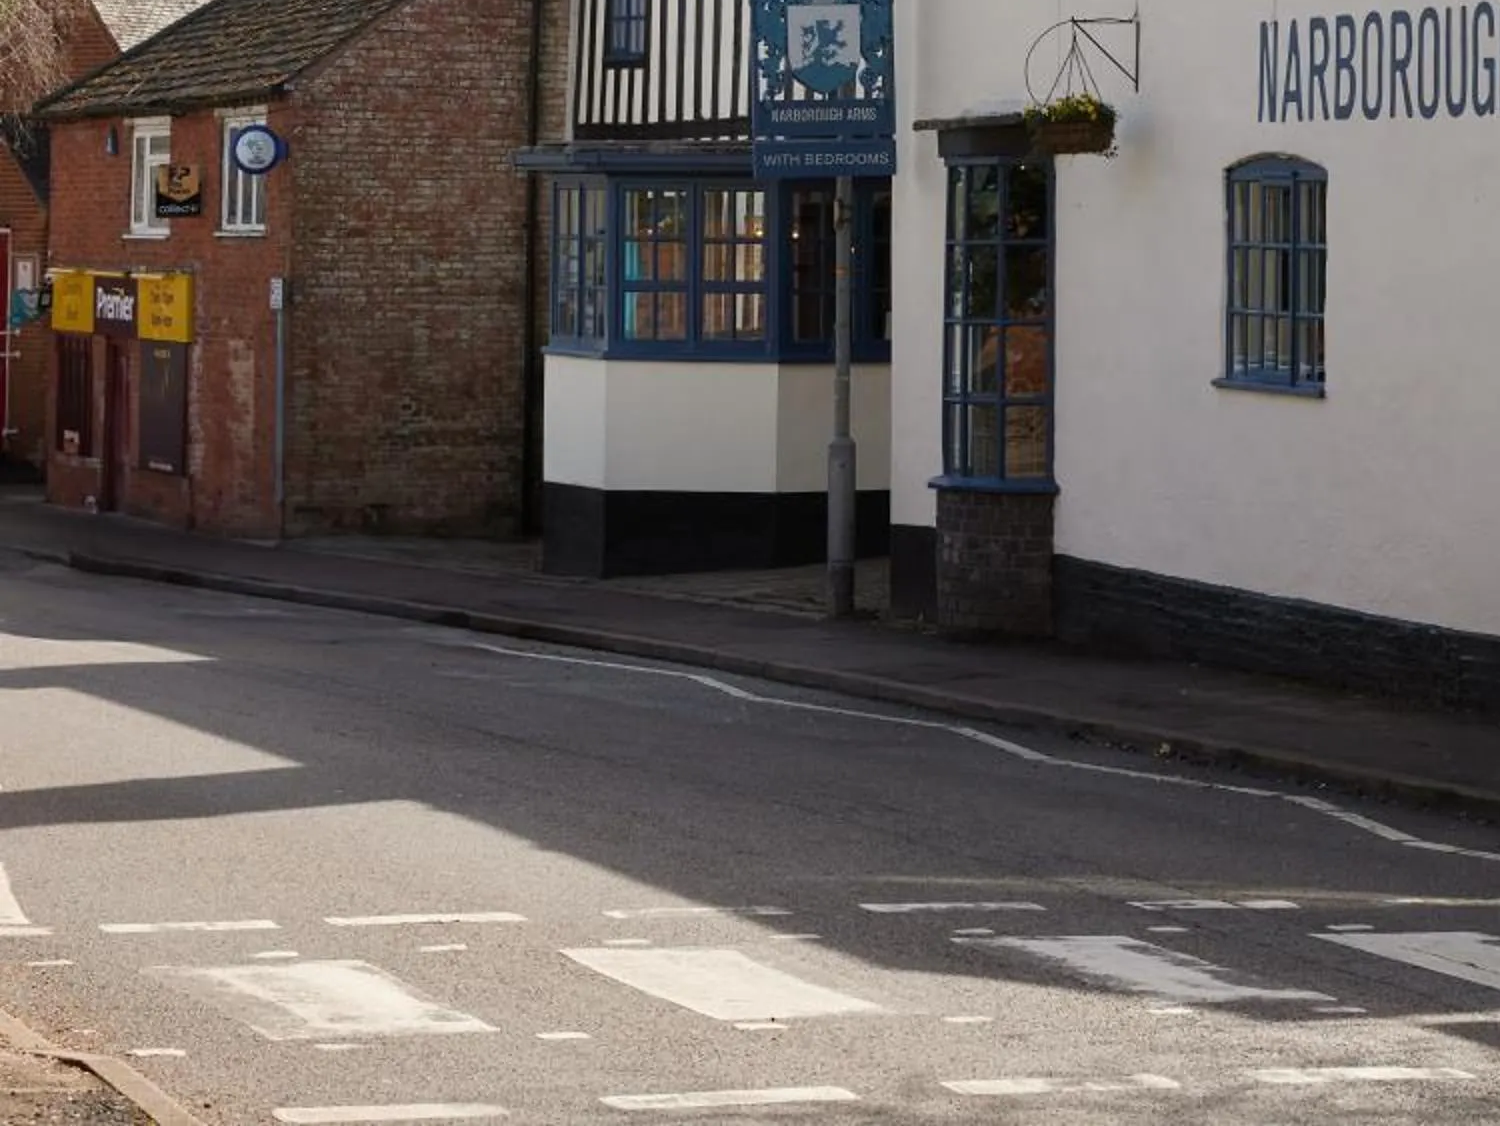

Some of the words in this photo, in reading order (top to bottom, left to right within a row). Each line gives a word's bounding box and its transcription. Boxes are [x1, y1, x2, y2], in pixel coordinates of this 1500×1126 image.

[771, 108, 843, 122] NARBOROUGH
[846, 107, 877, 120] ARMS
[762, 154, 801, 167] WITH
[804, 153, 889, 165] BEDROOMS
[96, 286, 135, 322] Premier
